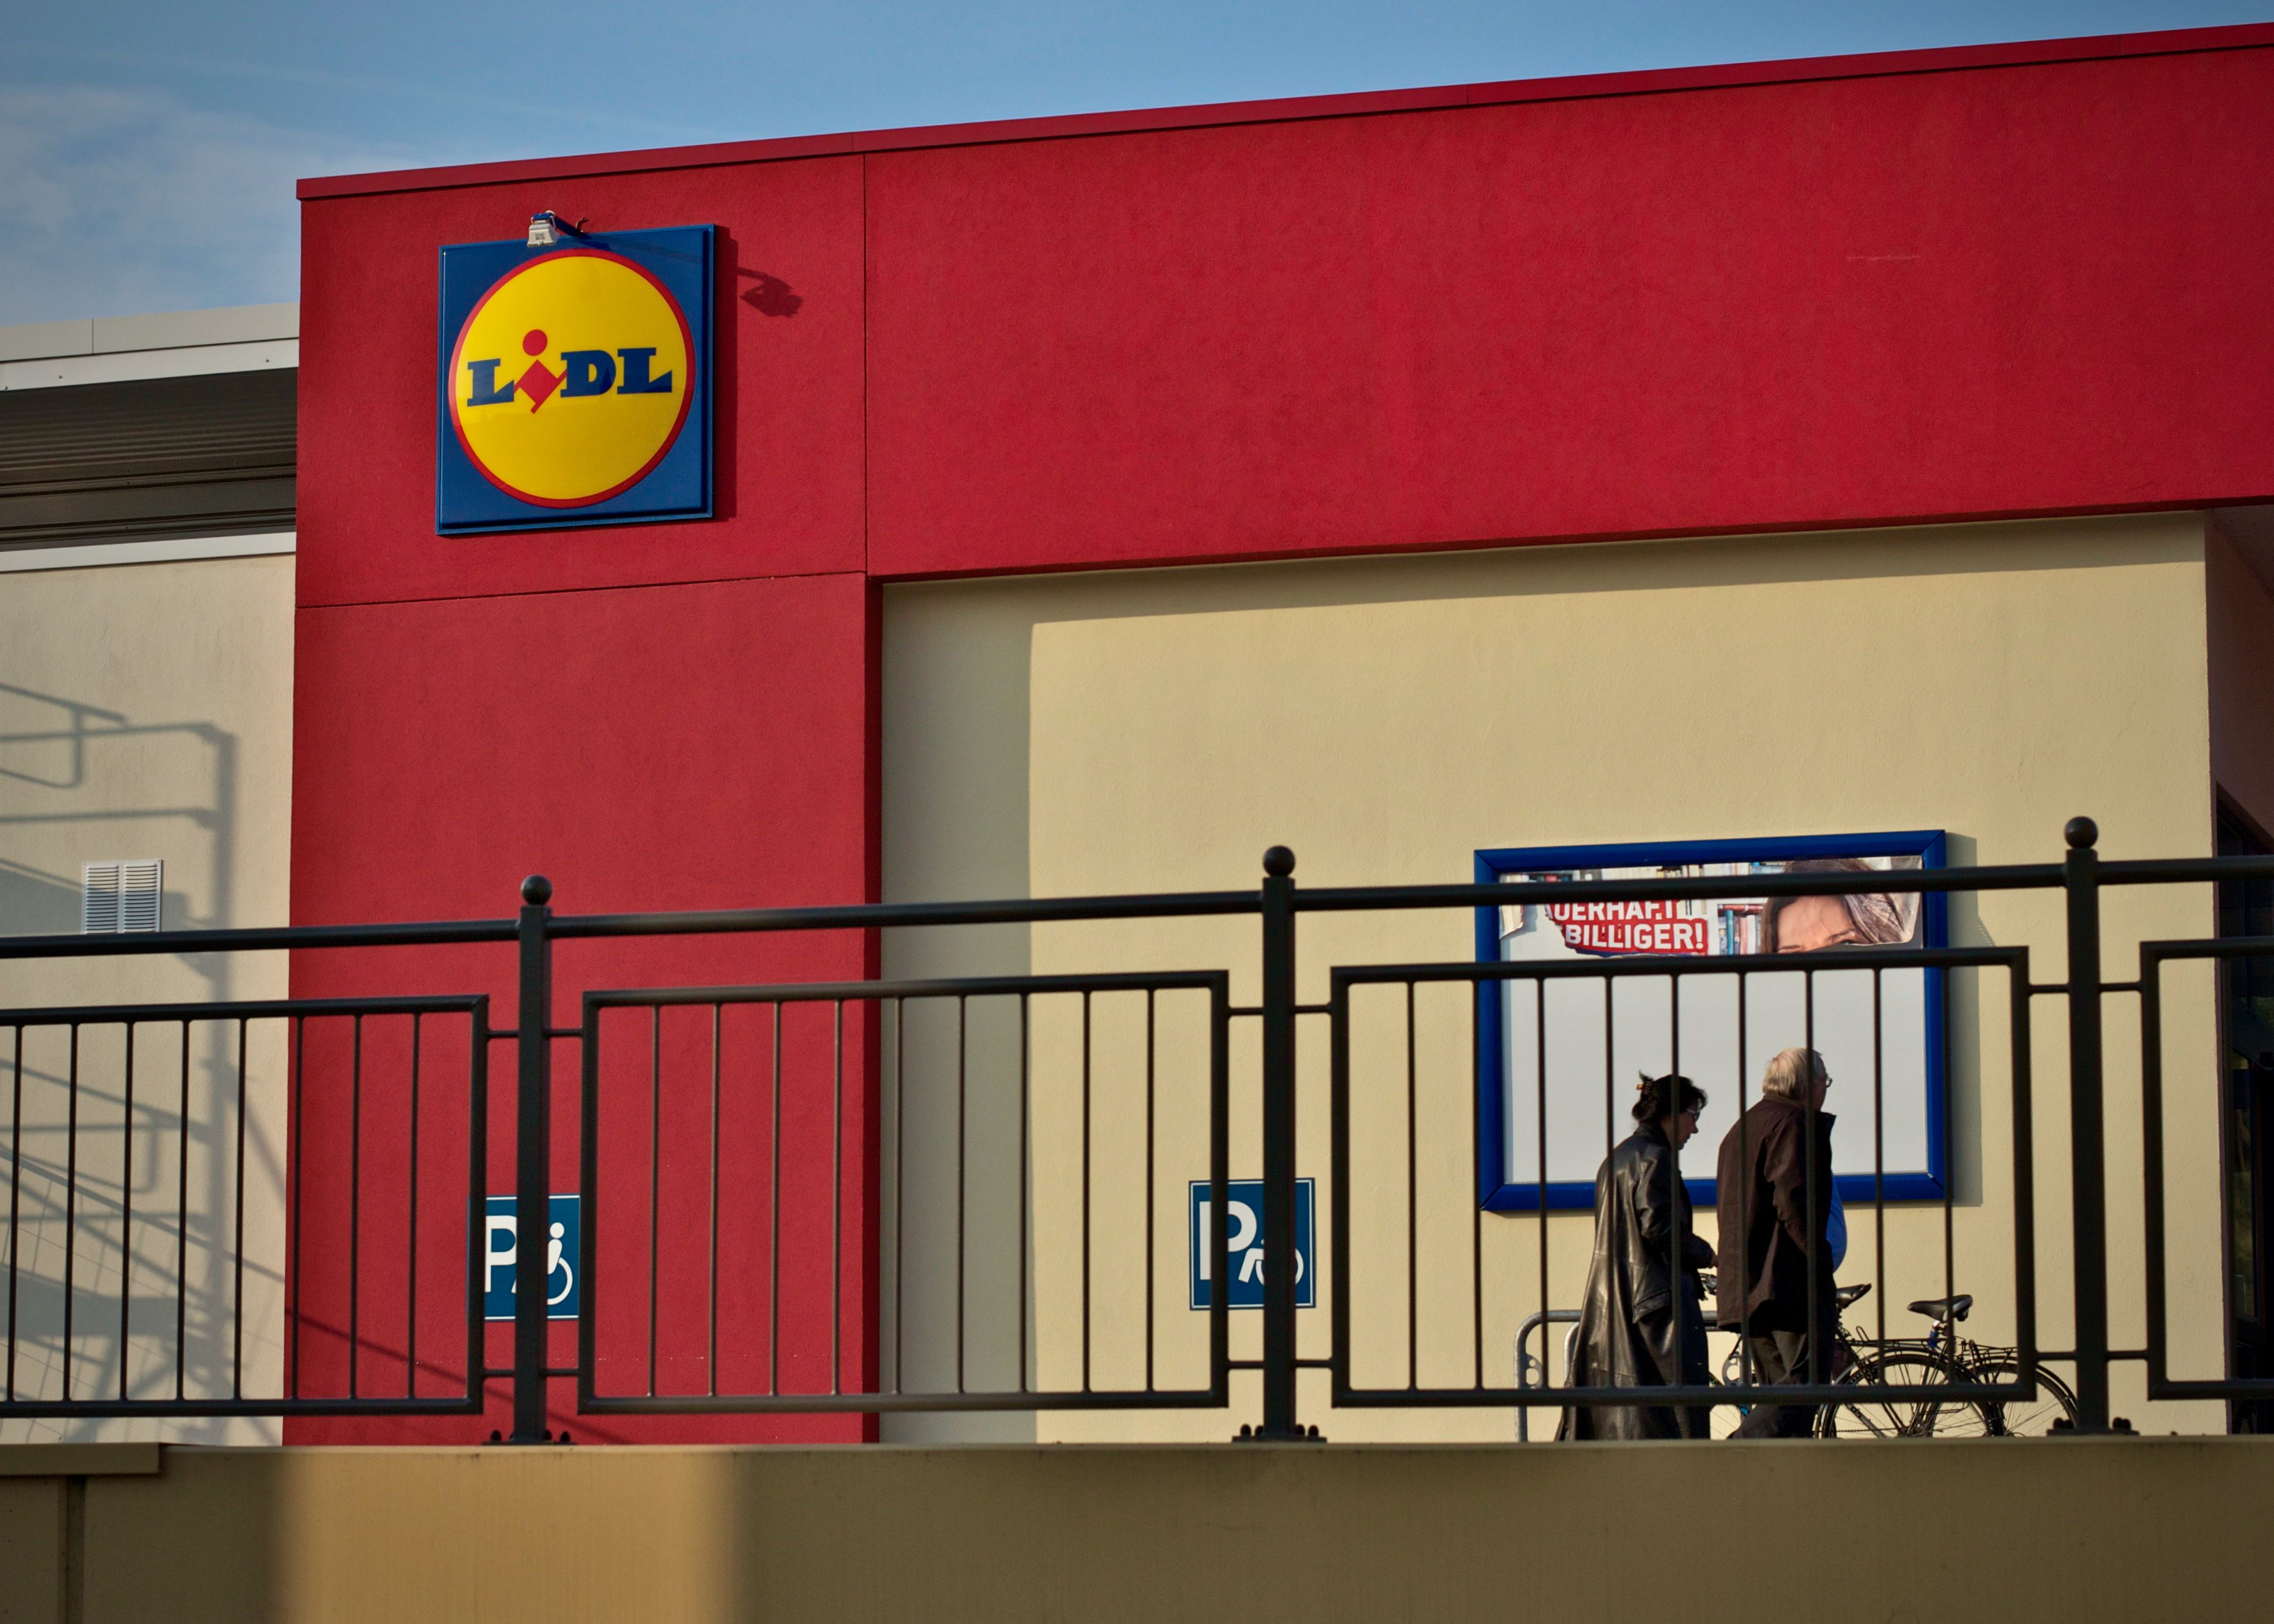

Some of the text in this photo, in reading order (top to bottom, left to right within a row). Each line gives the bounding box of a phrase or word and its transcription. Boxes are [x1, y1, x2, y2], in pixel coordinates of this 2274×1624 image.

[1545, 900, 1673, 920] UERHAFT
[1566, 923, 1703, 949] BILLIGER!
[484, 1215, 517, 1293] P
[1199, 1201, 1257, 1280] P
